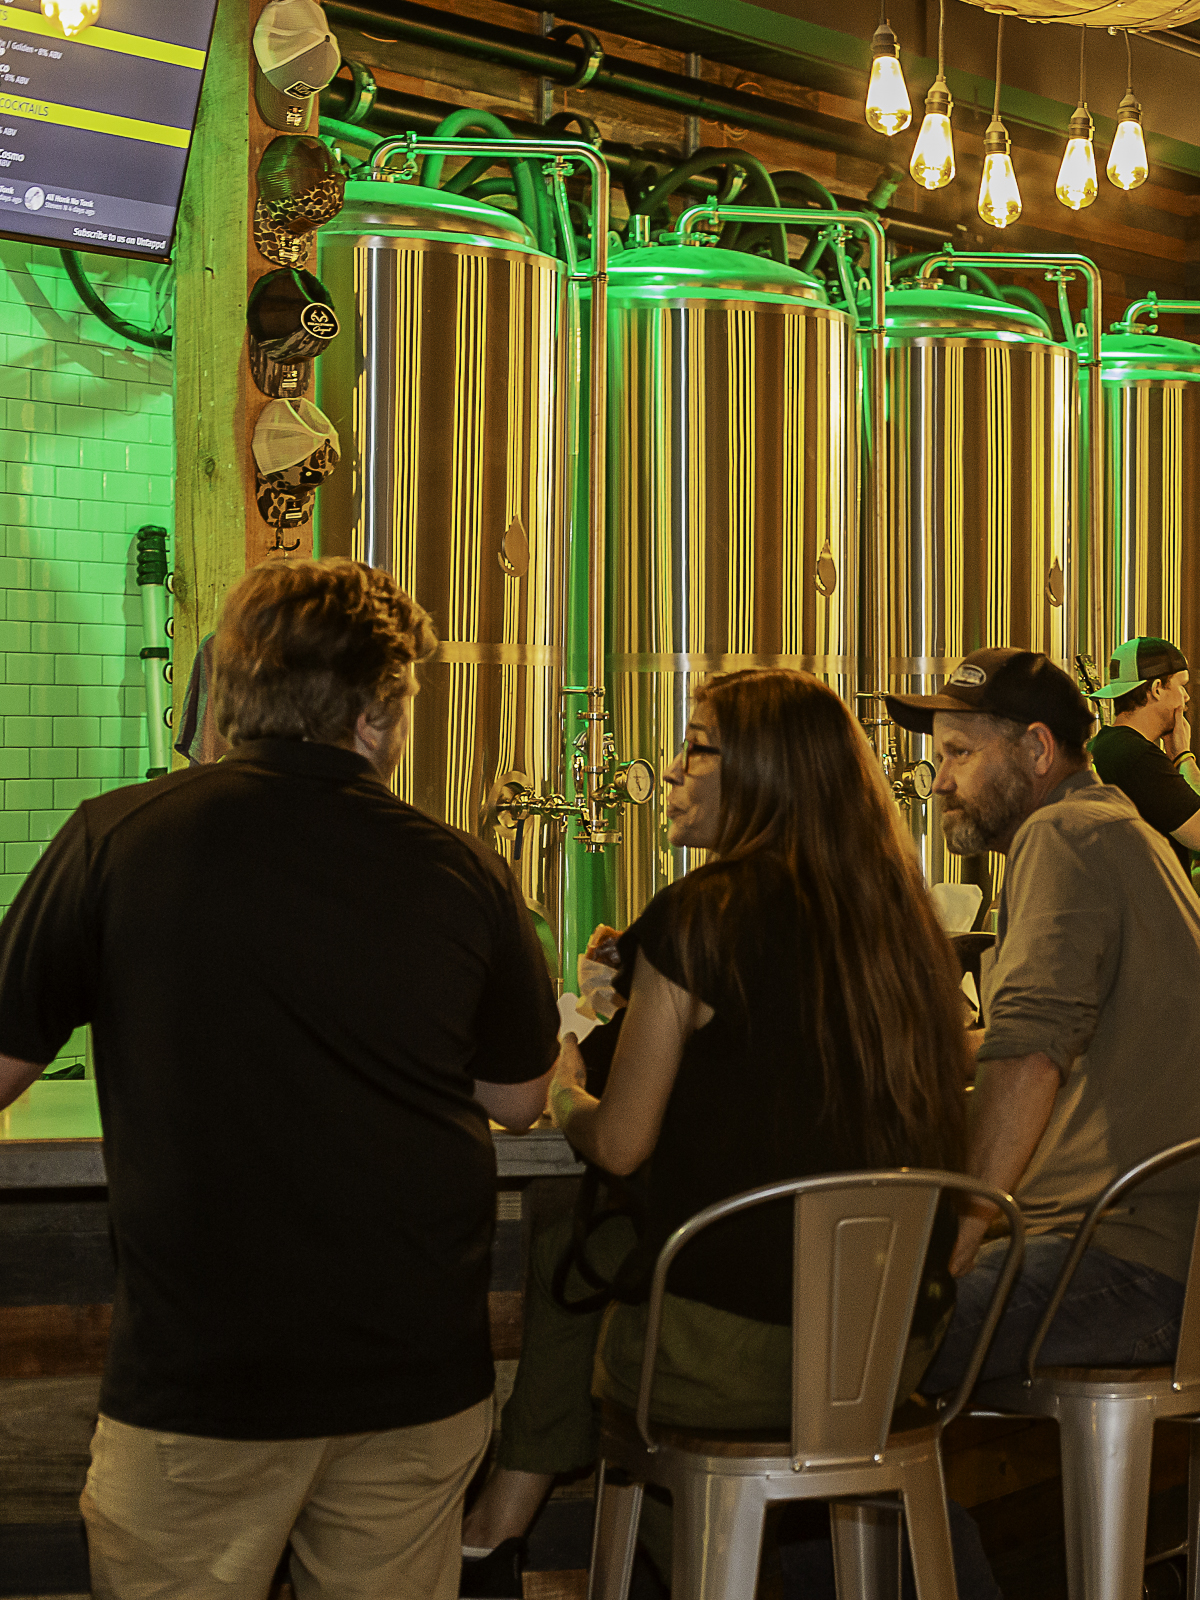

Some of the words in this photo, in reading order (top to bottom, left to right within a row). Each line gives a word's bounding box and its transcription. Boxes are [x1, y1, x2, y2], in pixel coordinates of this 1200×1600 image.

[0, 97, 49, 117] COCKTAILS
[73, 227, 108, 241] Subscribe
[107, 233, 117, 242] to
[116, 235, 126, 244] us
[126, 237, 136, 245] on
[136, 236, 167, 251] Untappd
